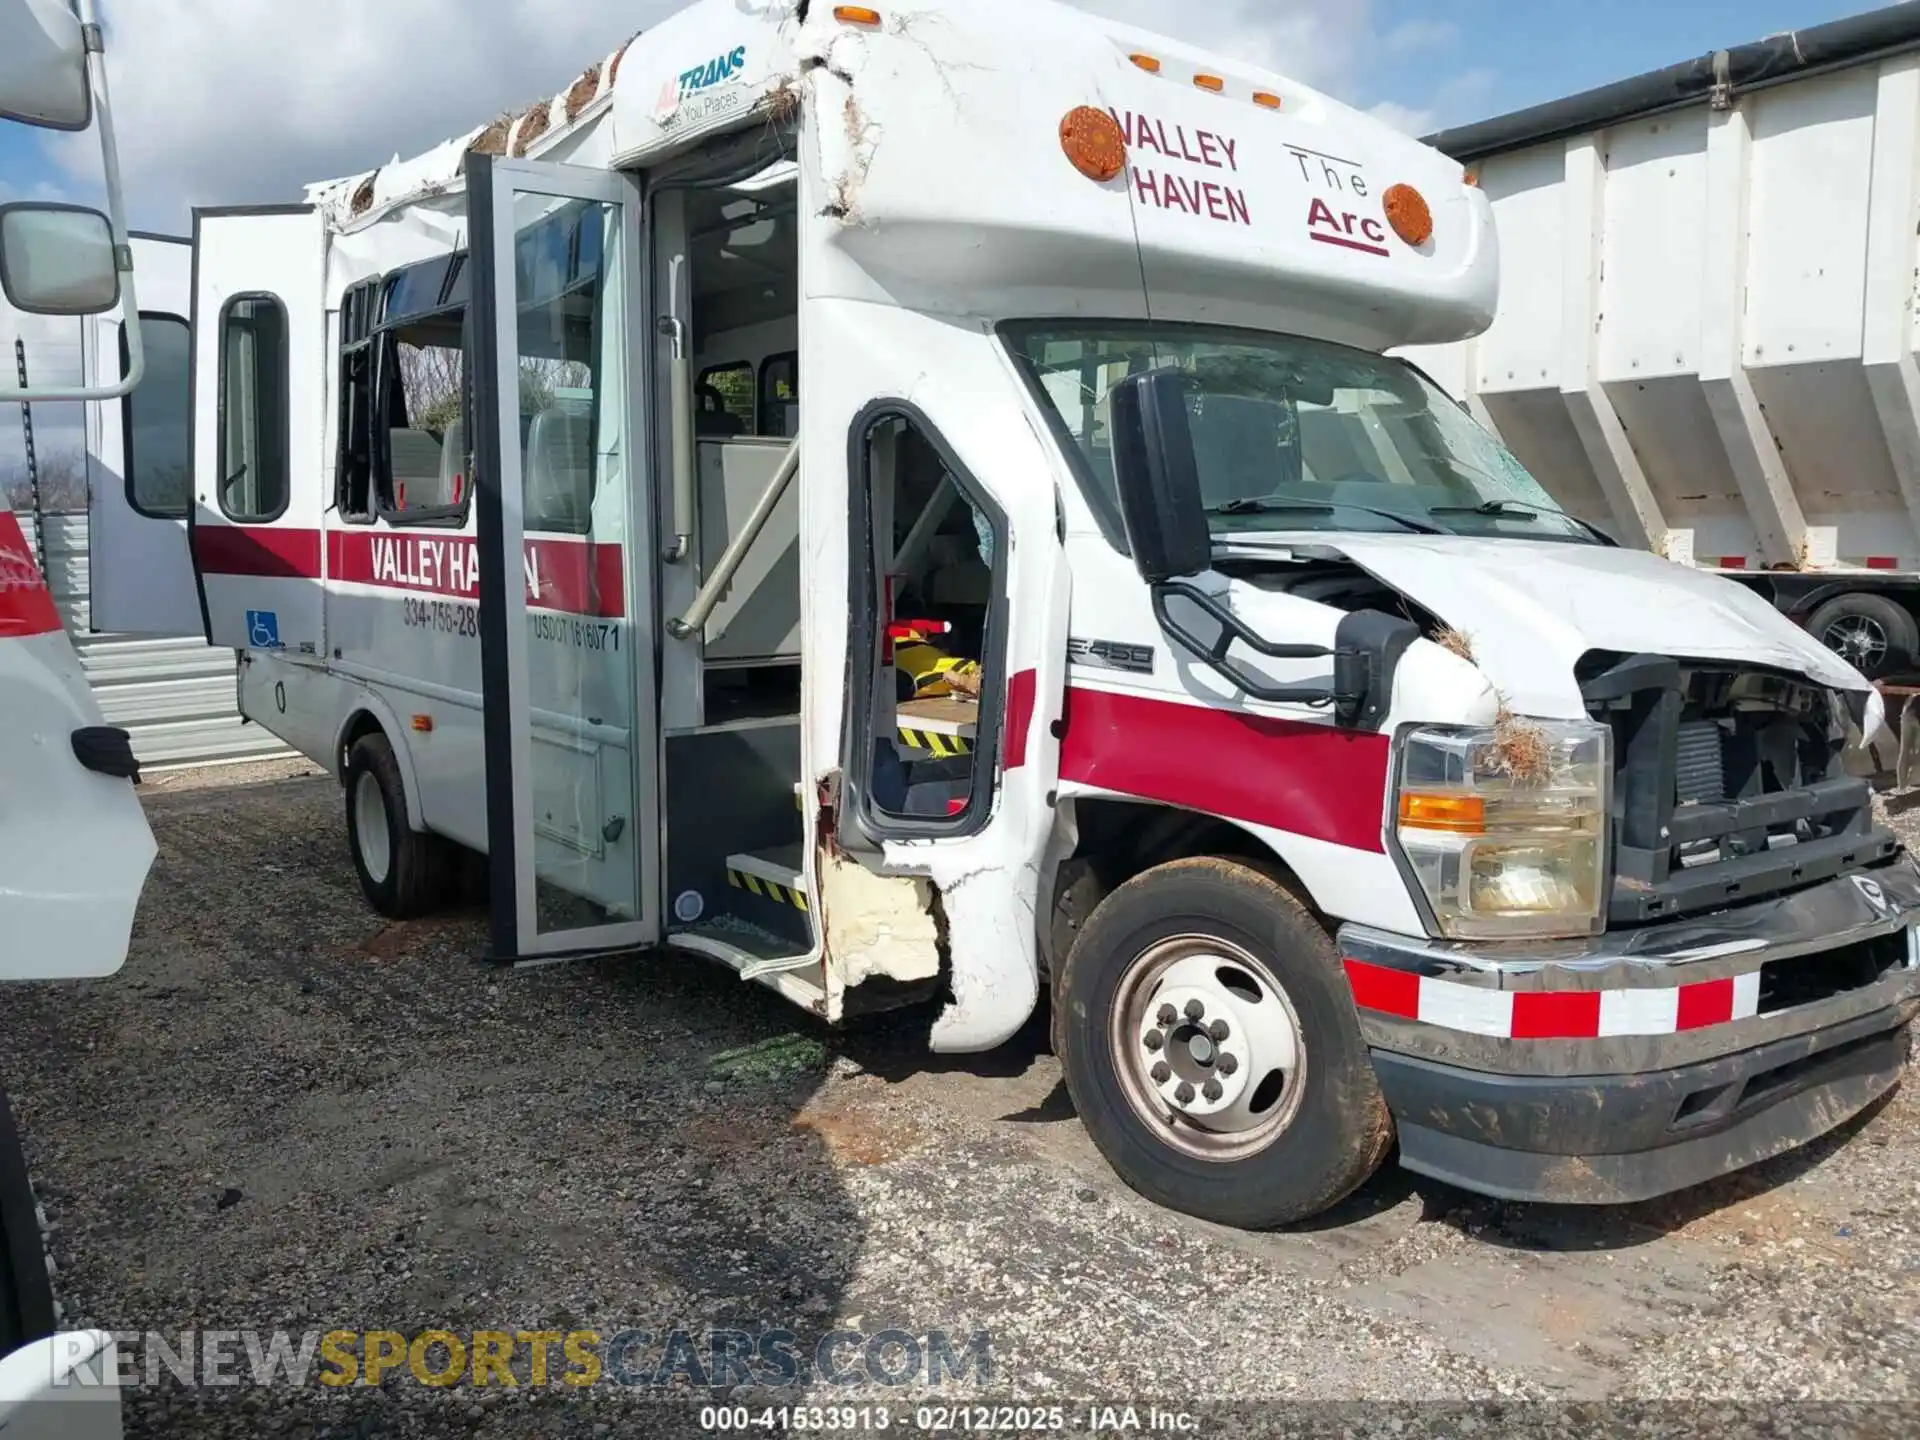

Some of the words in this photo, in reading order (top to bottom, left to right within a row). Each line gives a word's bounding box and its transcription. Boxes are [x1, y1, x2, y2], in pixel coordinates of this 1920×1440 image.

[682, 102, 704, 121] You
[704, 91, 739, 116] Places
[1108, 106, 1238, 172] VALLEY
[1132, 166, 1250, 226] HAVEN
[1290, 151, 1368, 198] The
[1307, 198, 1386, 243] Arc
[370, 537, 444, 587] VALLEY
[450, 542, 540, 600] HAN
[403, 596, 482, 638] 334-756-28
[534, 614, 567, 645] USDOT
